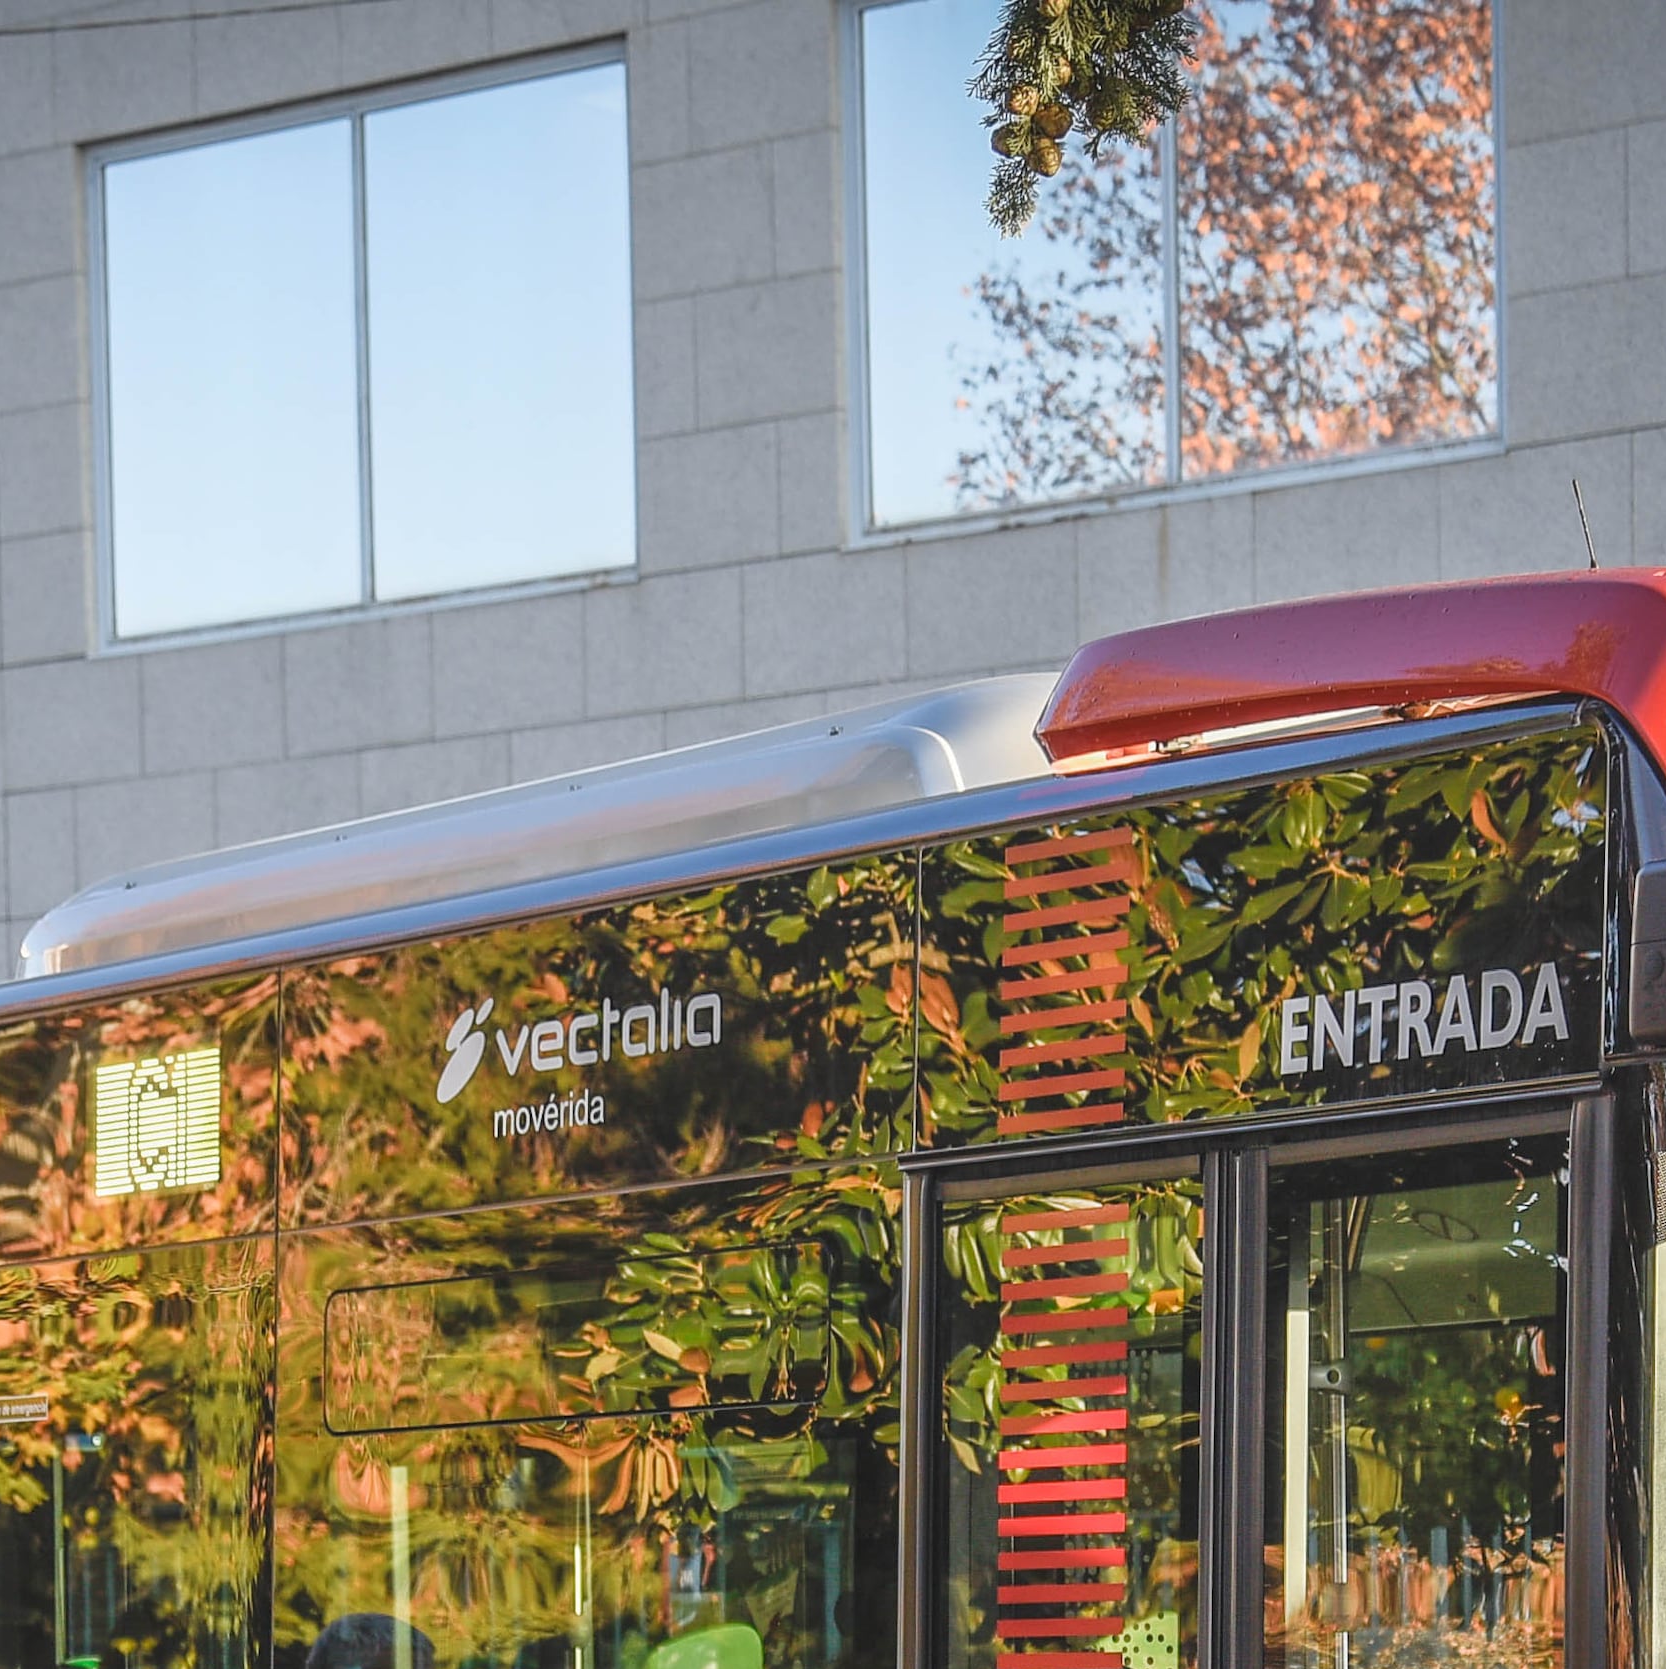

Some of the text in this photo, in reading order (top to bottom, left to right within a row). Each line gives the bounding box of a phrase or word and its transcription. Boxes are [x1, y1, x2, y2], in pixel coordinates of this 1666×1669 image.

[496, 986, 722, 1077] vectalia
[1280, 961, 1570, 1076] ENTRADA
[493, 1087, 606, 1139] movérida
